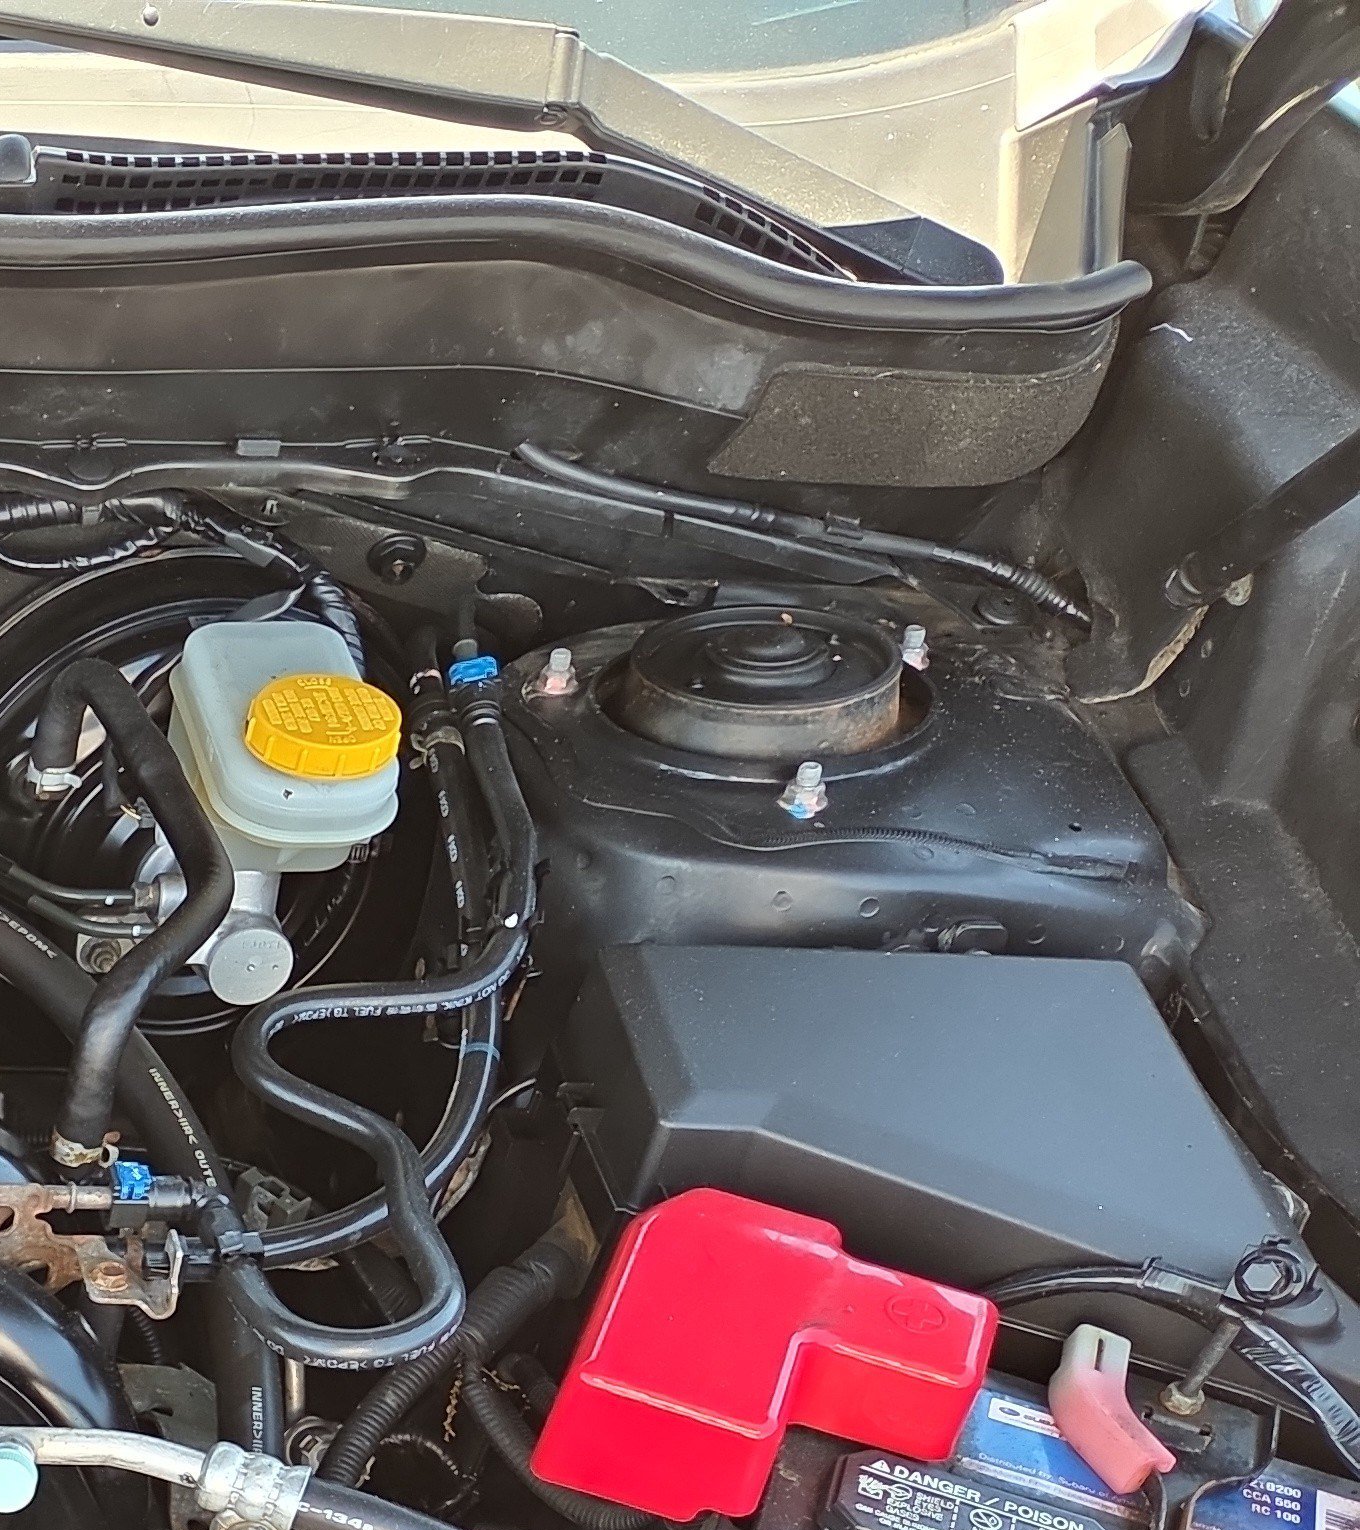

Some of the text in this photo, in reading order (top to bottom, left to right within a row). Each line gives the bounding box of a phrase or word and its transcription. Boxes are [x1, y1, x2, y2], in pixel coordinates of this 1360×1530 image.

[893, 1465, 981, 1503] DANGER
[915, 1492, 955, 1510] SHIELD
[1243, 1488, 1272, 1504] CCA
[1251, 1502, 1302, 1525] RC 100
